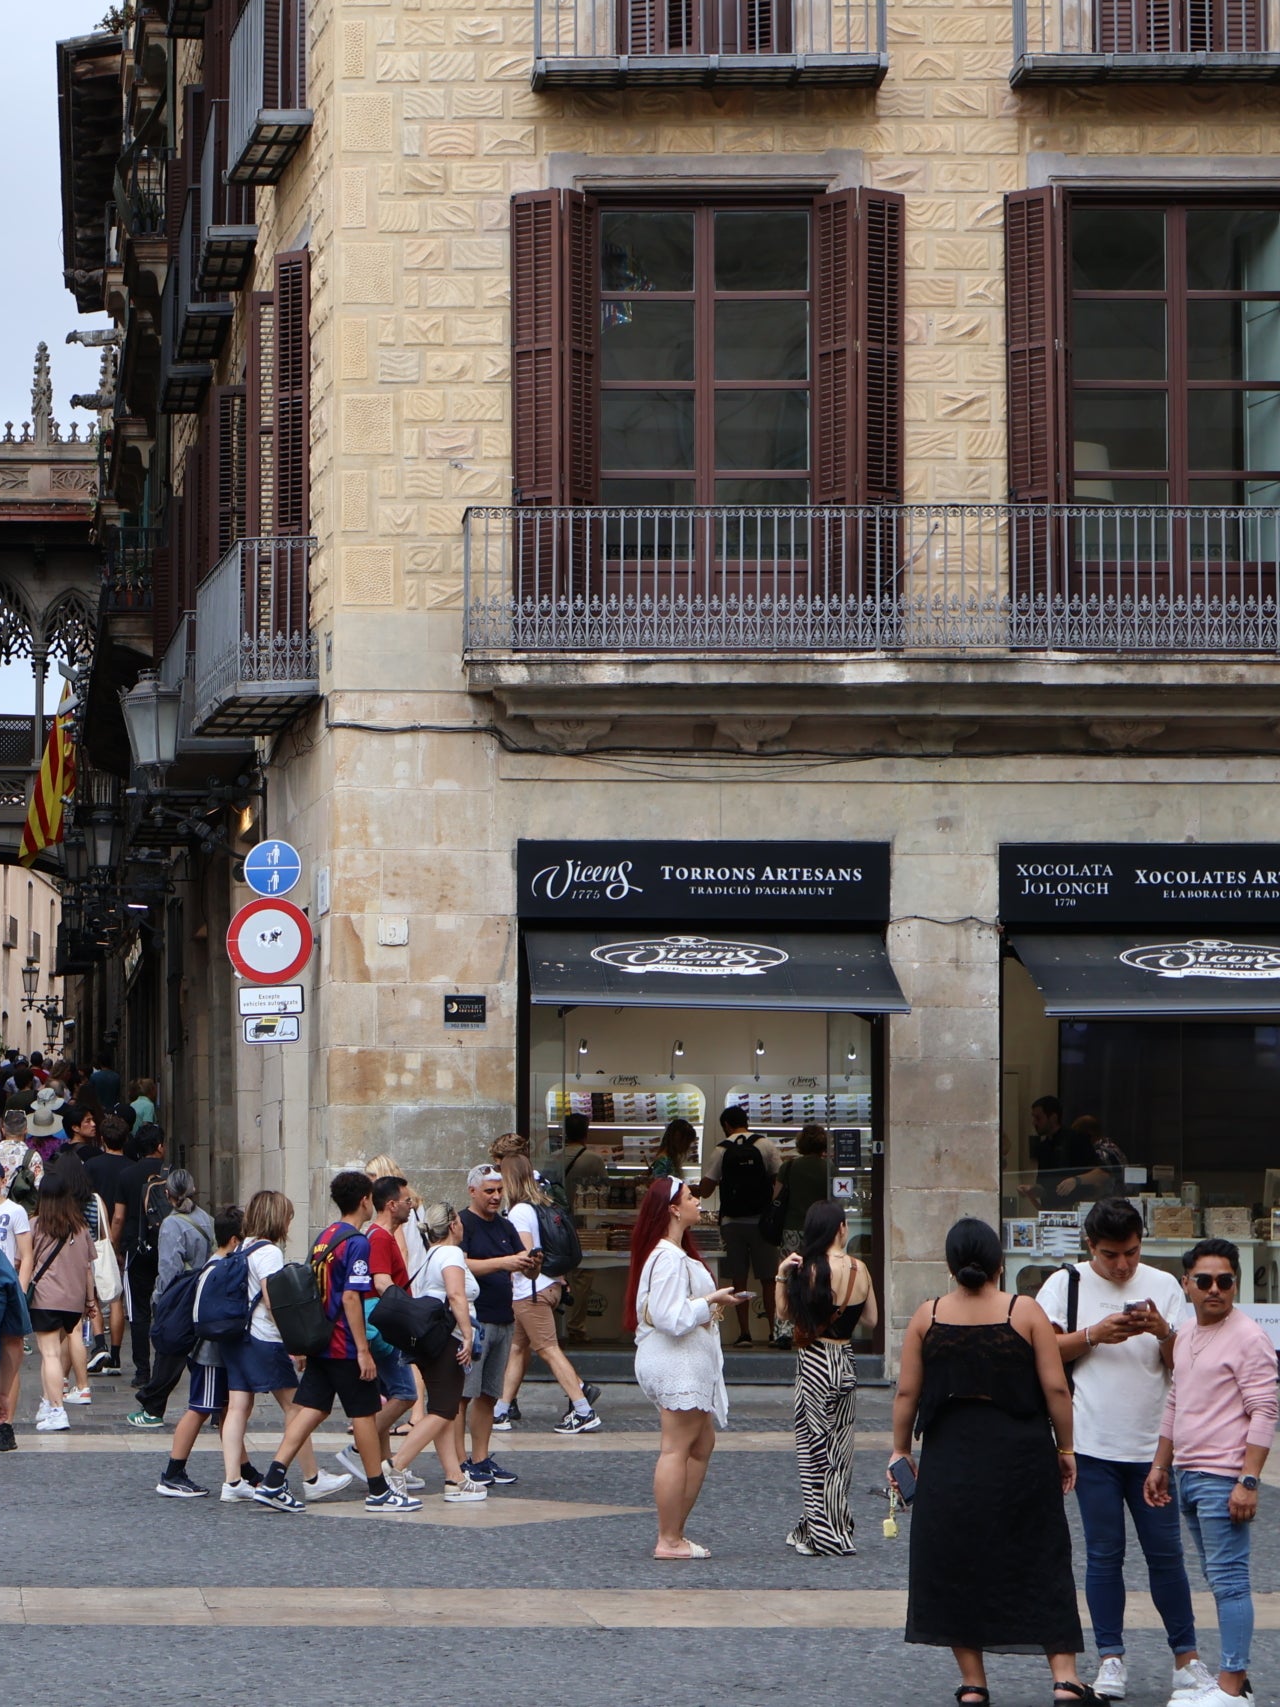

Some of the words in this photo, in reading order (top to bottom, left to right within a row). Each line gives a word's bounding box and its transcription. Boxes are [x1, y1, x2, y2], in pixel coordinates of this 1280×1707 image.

[660, 865, 756, 881] TORRONS
[760, 866, 863, 882] ARTESANS
[1016, 863, 1114, 877] XOCOLATA
[1134, 869, 1247, 885] XOCOLATES
[1251, 869, 1280, 885] AR
[531, 859, 644, 900] Vicens
[1020, 879, 1109, 895] JOLONCH
[571, 889, 601, 900] 1775
[689, 884, 751, 895] TRADICIÓ
[755, 886, 835, 896] D'AGRAMUNT
[1163, 889, 1242, 899] ELABORACIÓ
[1246, 890, 1280, 899] TRAD
[1054, 898, 1076, 907] 1770
[605, 948, 778, 967] Vicens
